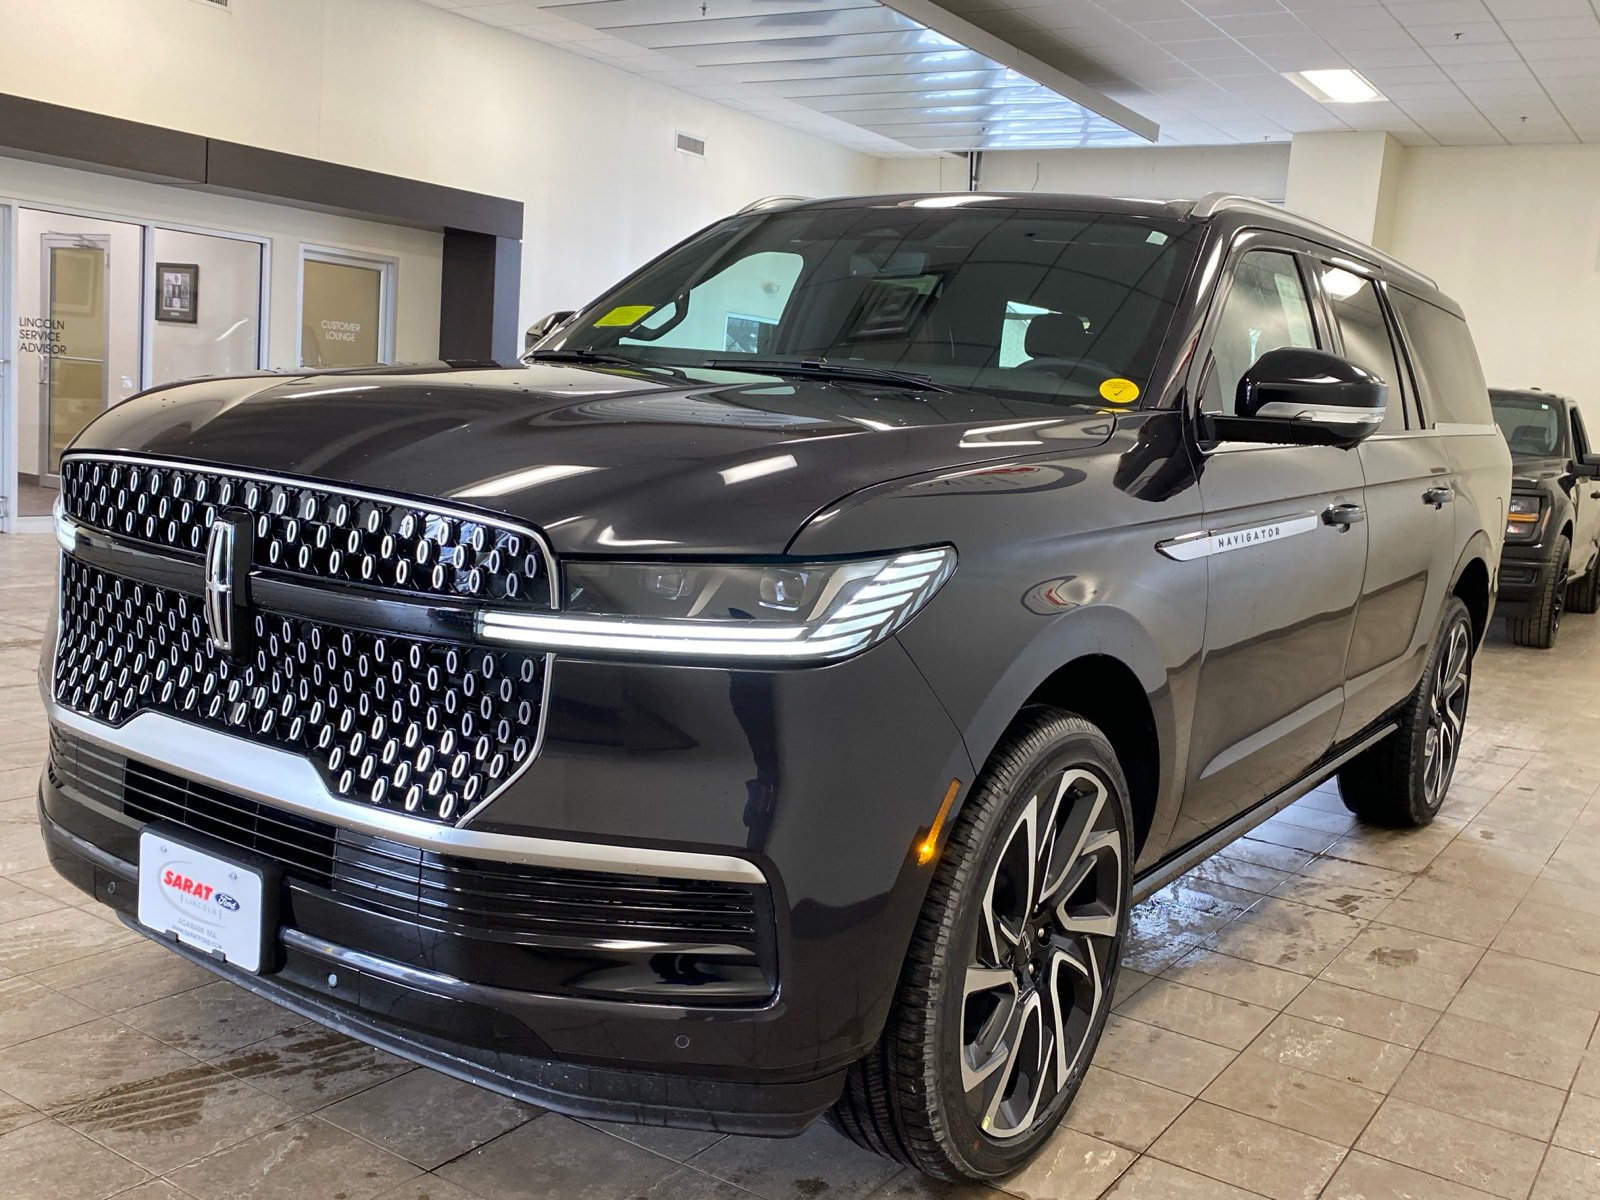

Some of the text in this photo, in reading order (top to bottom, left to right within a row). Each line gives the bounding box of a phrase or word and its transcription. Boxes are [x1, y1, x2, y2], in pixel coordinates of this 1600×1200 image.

[19, 317, 65, 329] LINCOLN
[321, 319, 361, 332] CUSTOMER
[19, 329, 61, 342] SERVICE
[325, 331, 356, 341] LOUNGE
[19, 342, 67, 354] ADVISOR
[1218, 527, 1280, 548] NAVIGATOR
[163, 870, 213, 900] SARAT
[218, 893, 238, 910] Ford
